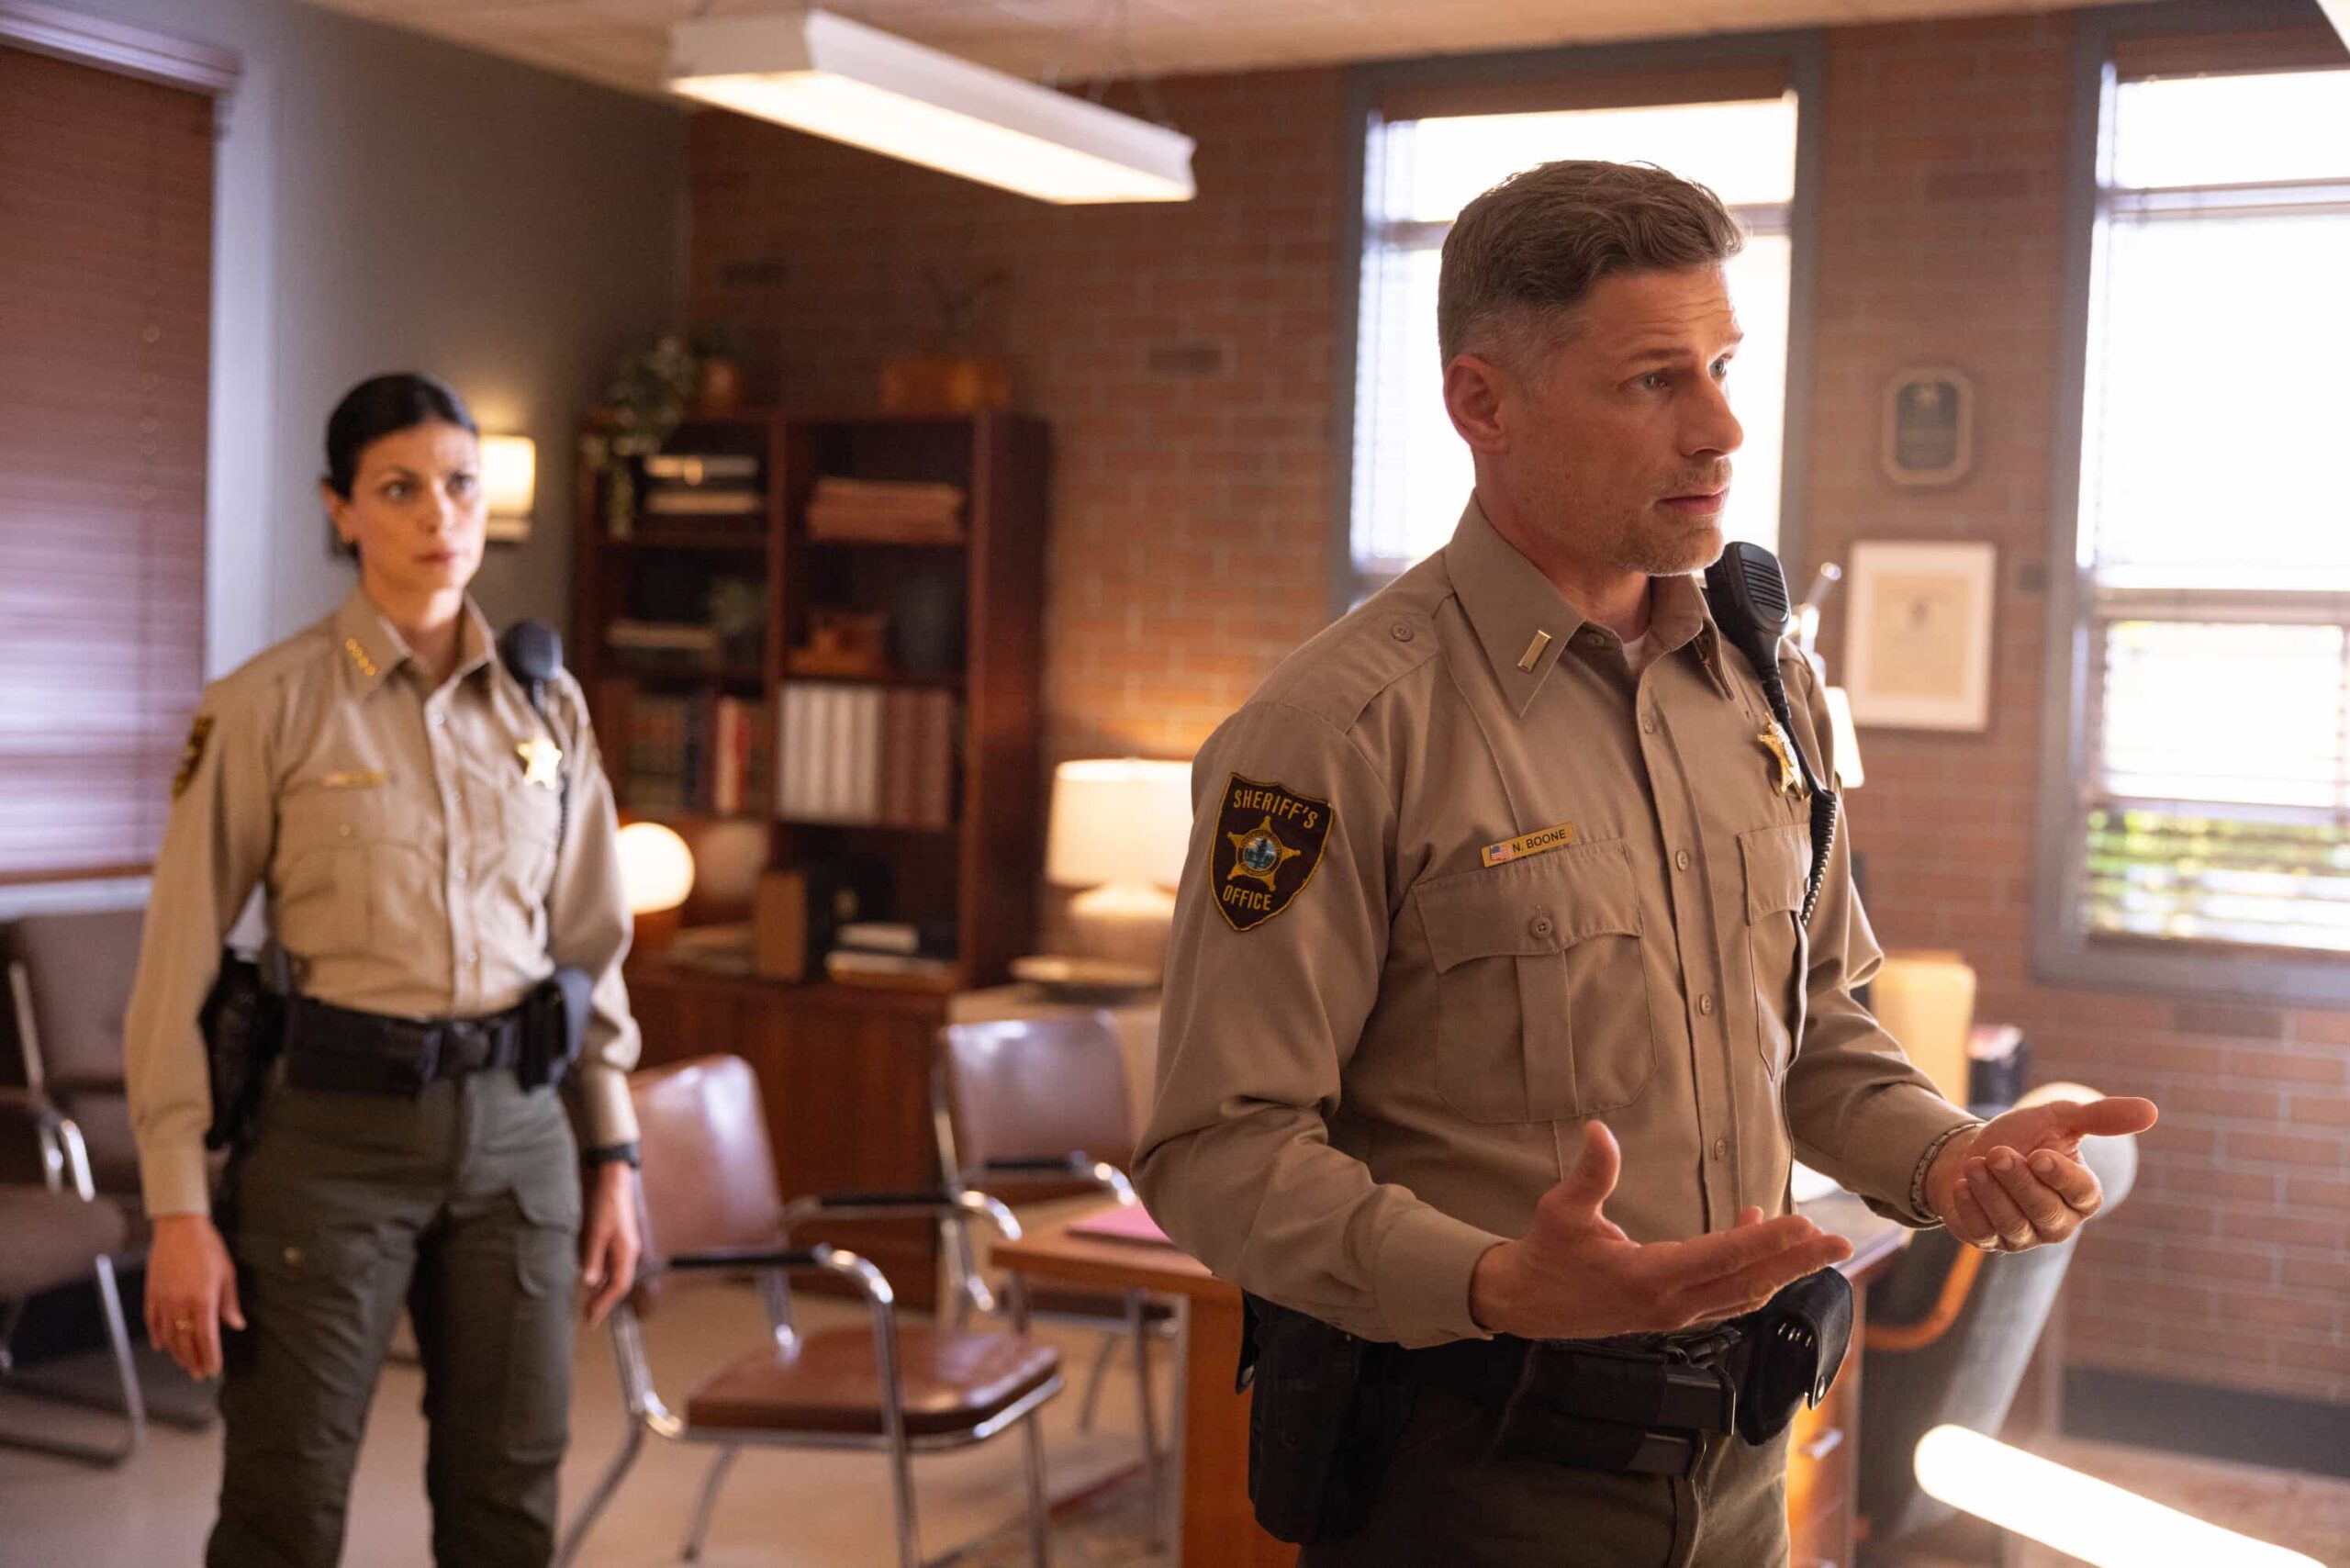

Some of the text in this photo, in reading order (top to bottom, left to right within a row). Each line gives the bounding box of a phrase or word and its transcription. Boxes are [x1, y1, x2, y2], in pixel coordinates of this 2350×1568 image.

[1233, 790, 1318, 829] SHERIFF'S
[1512, 828, 1566, 853] N. BOONE
[1222, 884, 1272, 912] OFFICE
